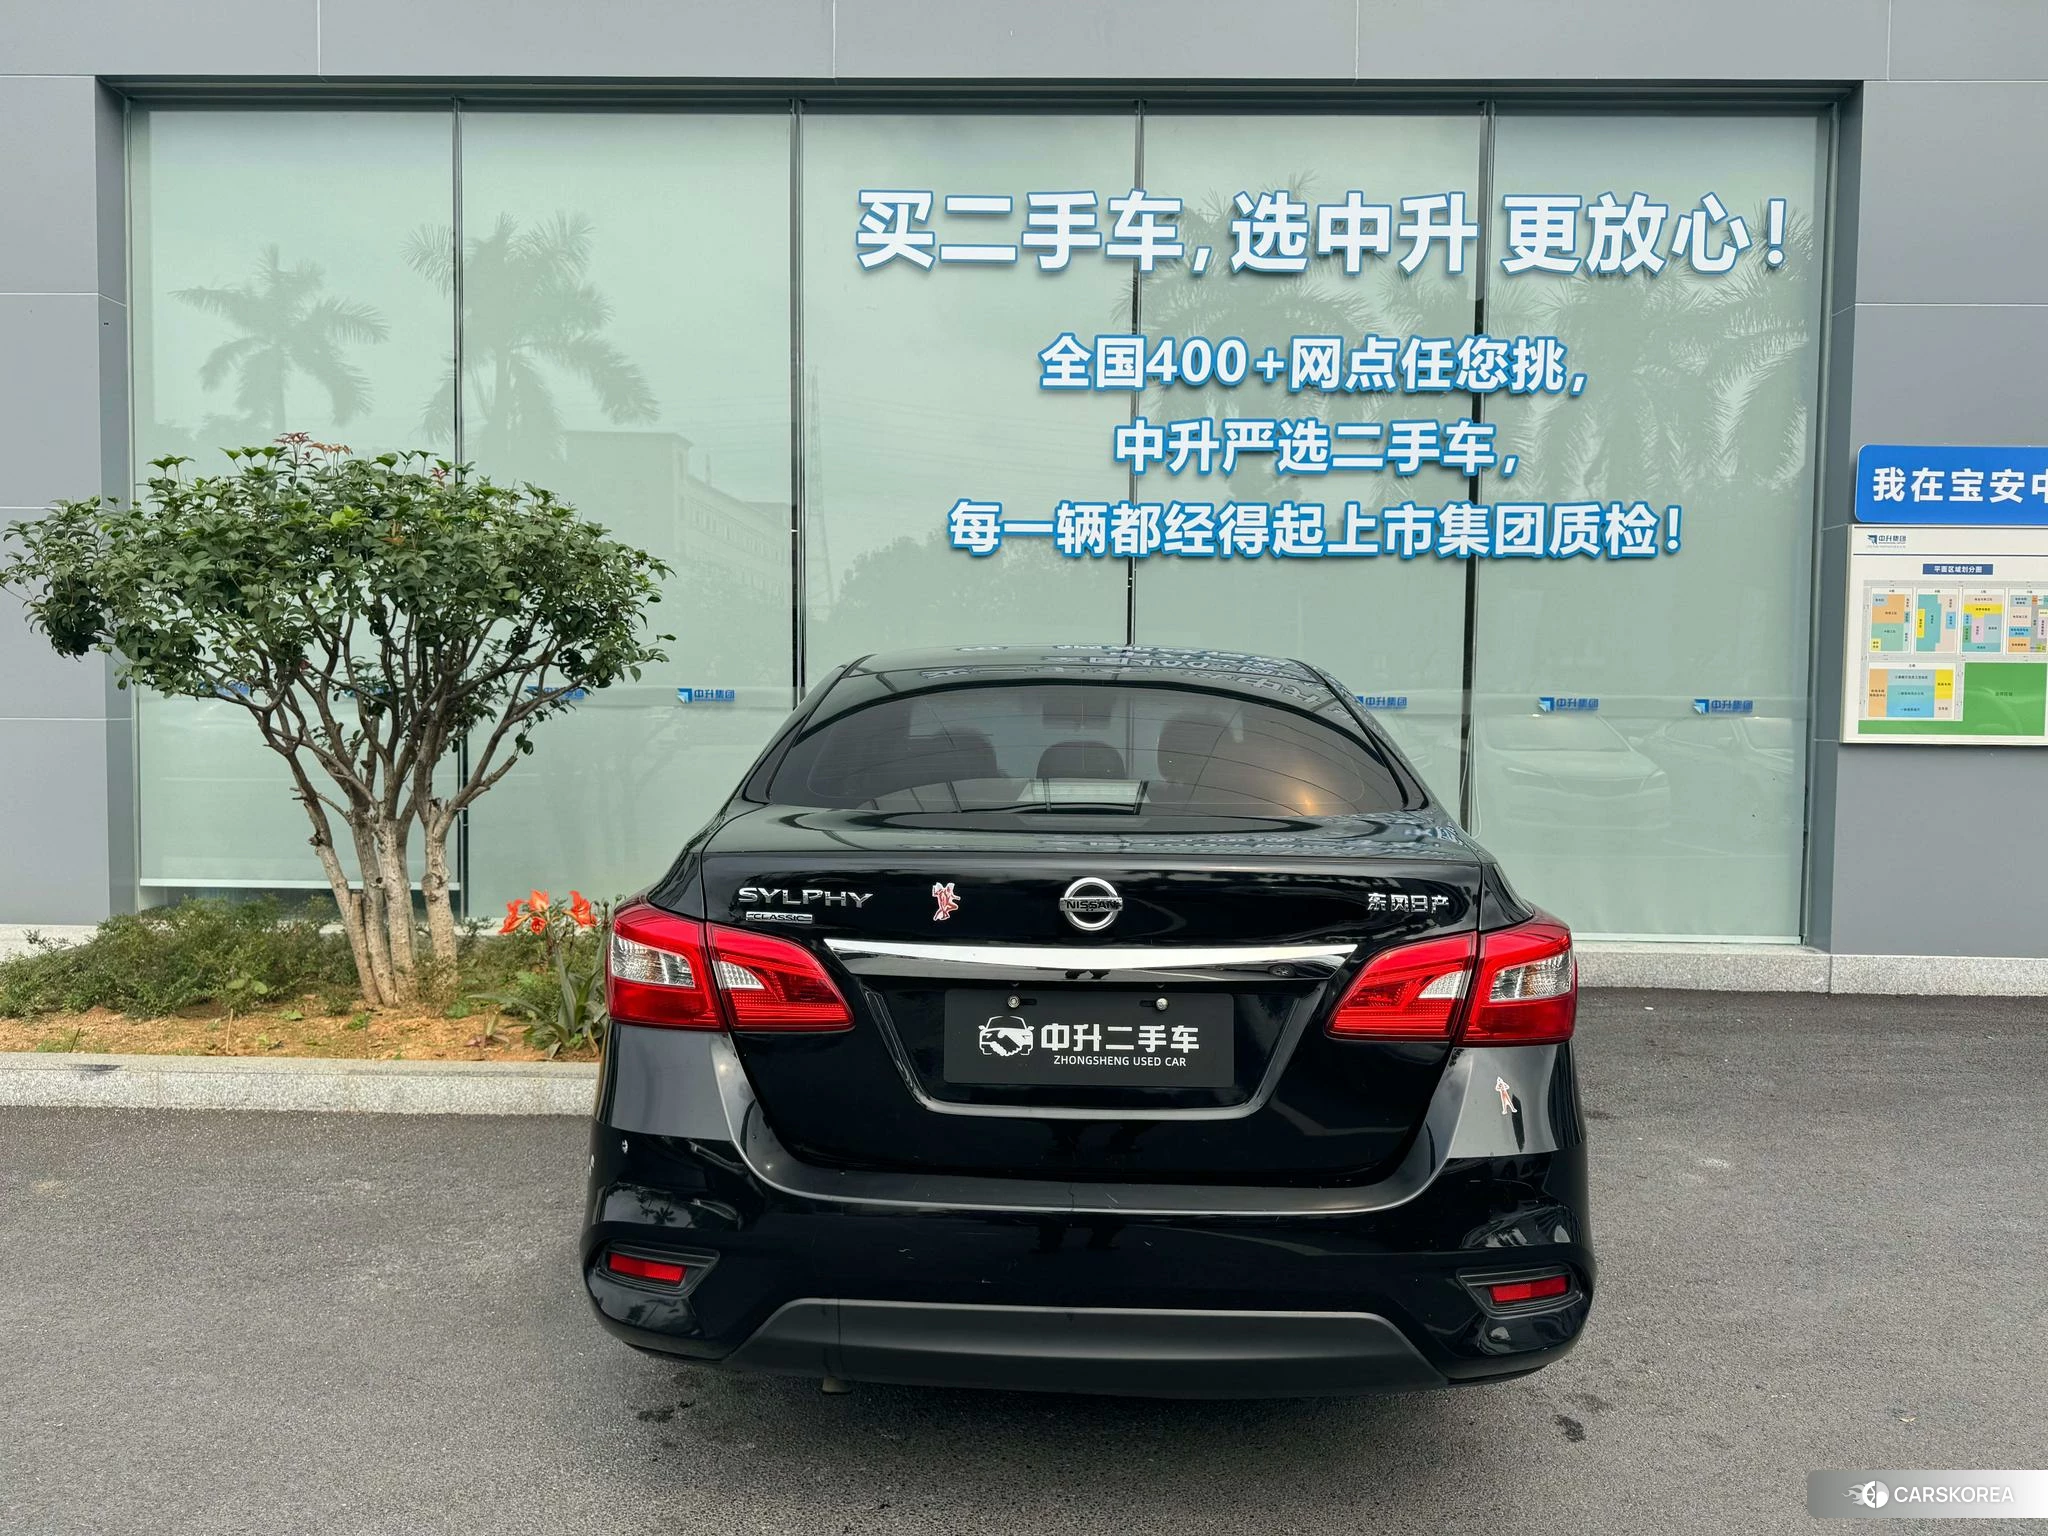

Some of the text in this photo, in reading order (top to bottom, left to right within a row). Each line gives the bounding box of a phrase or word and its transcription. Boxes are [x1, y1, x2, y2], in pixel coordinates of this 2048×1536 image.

[1501, 191, 1789, 276] 更放心!
[1038, 332, 1588, 394] 全国400+网点任您挑,
[1113, 418, 1520, 477] 中升严选二手车,
[948, 499, 1684, 562] 每一辆都经得起上市集团质检!
[738, 886, 874, 909] SYLPHY
[1066, 900, 1116, 909] NISSAN
[1367, 892, 1450, 914] 东风日产
[752, 913, 803, 922] CLASSIC
[1040, 1023, 1200, 1054] 中升二手车
[1053, 1055, 1187, 1067] ZHONGSHENG USED CAR
